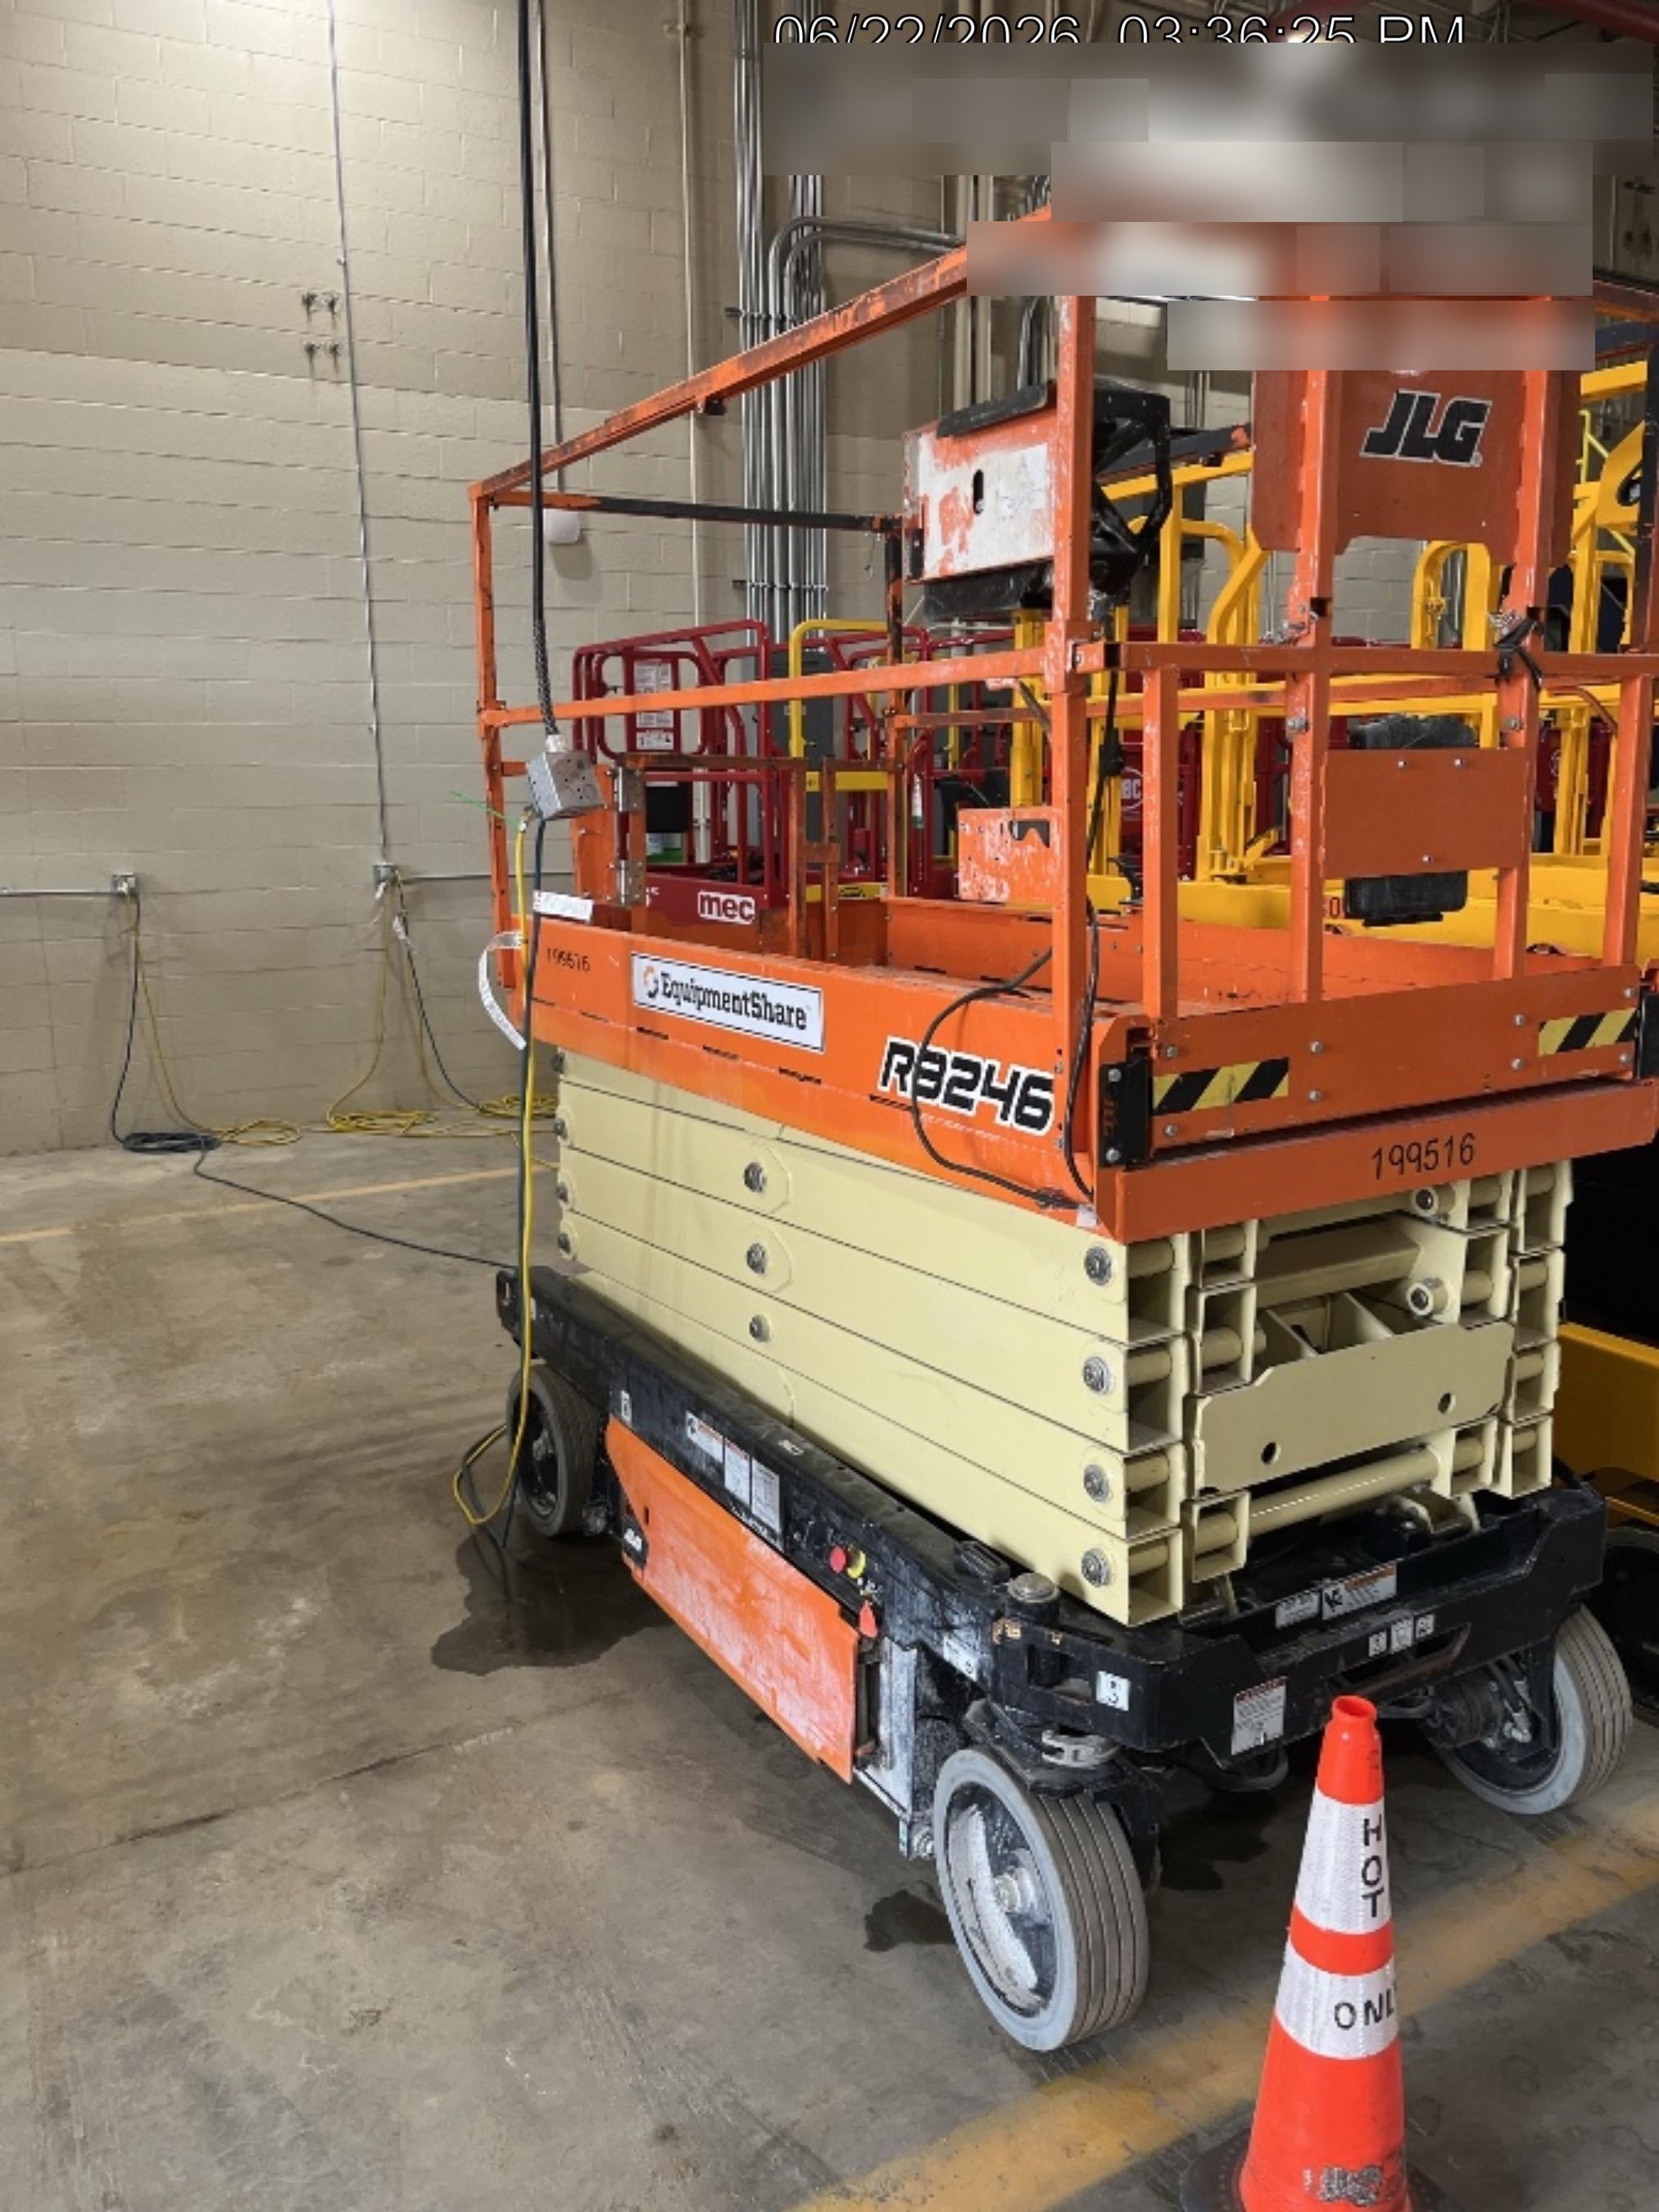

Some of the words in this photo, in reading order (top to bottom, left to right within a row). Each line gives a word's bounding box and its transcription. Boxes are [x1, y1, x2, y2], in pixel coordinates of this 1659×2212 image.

[1360, 388, 1493, 467] JLG
[699, 892, 755, 922] mec
[660, 970, 807, 1031] EquipmentShare
[1371, 1131, 1475, 1181] 199516
[1361, 1813, 1385, 1918] HOT
[1334, 1983, 1396, 2030] ONL
